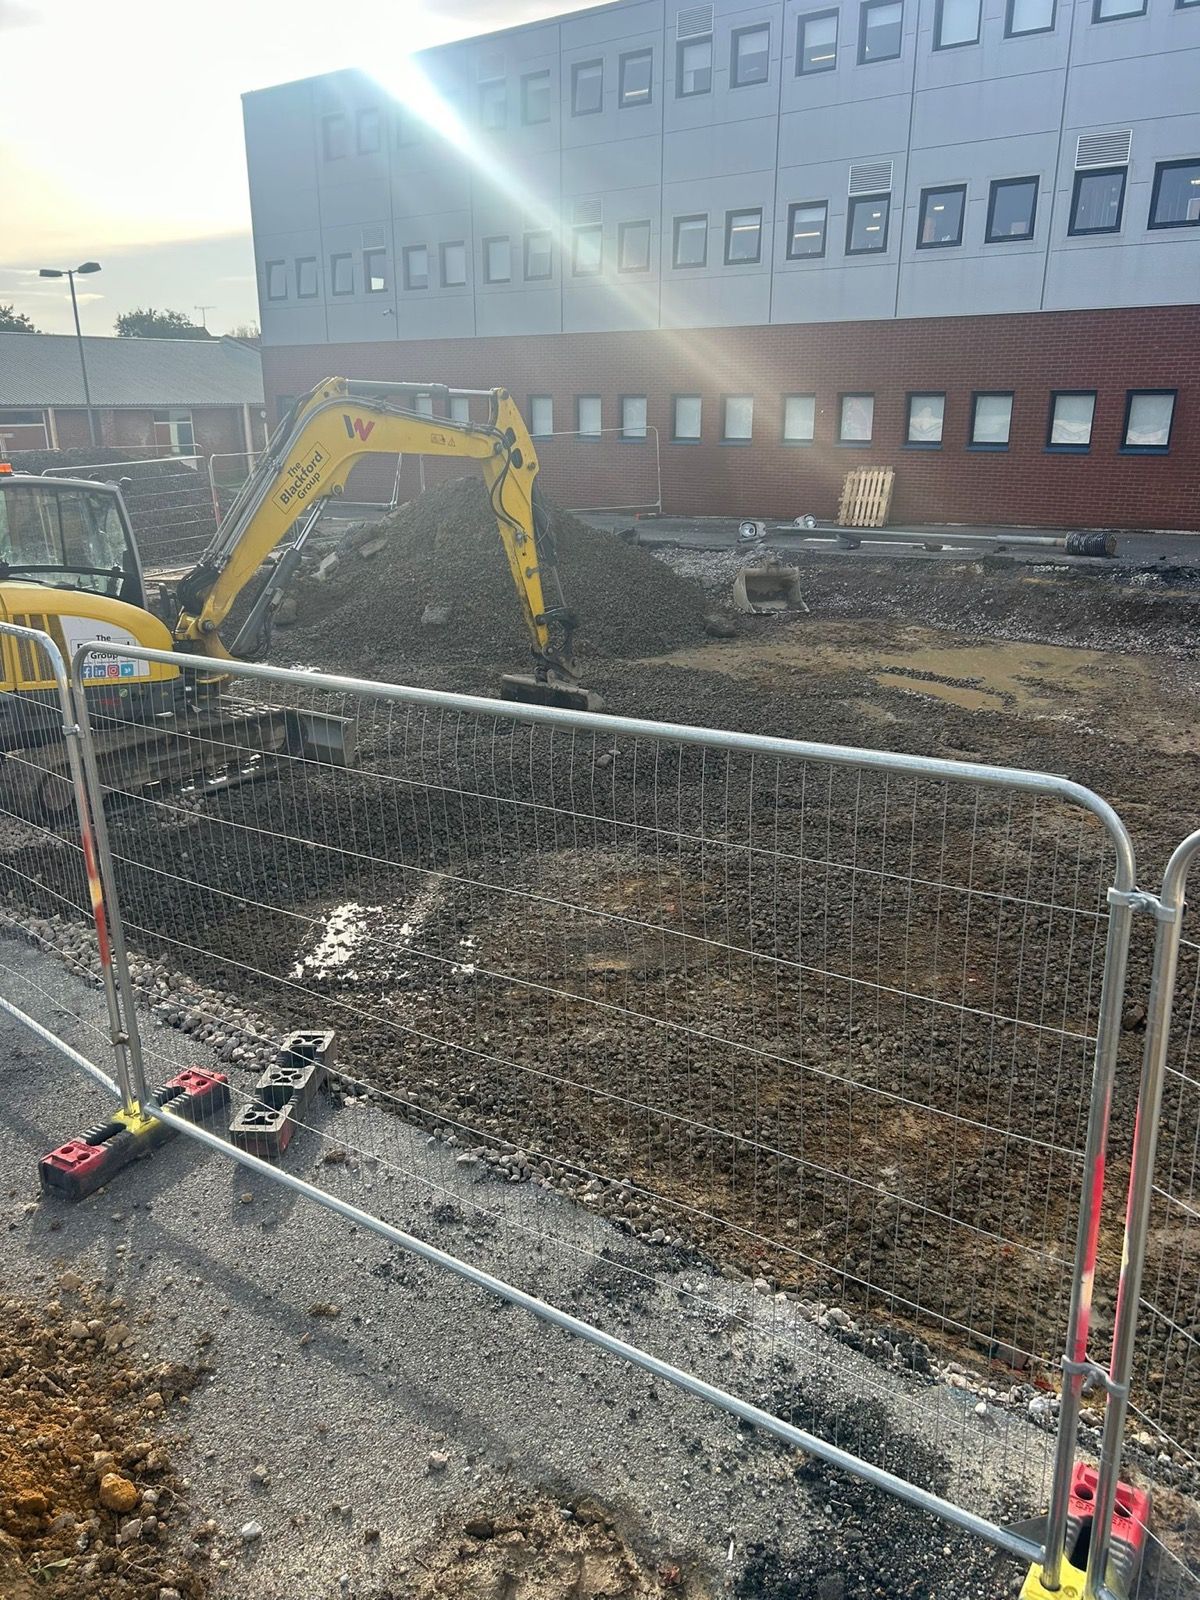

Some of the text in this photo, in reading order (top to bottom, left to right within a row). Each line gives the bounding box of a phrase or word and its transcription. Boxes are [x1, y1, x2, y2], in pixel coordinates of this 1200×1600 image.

[280, 451, 323, 504] Blackford
[287, 462, 301, 477] The
[297, 472, 320, 499] Group
[90, 652, 119, 660] Group
